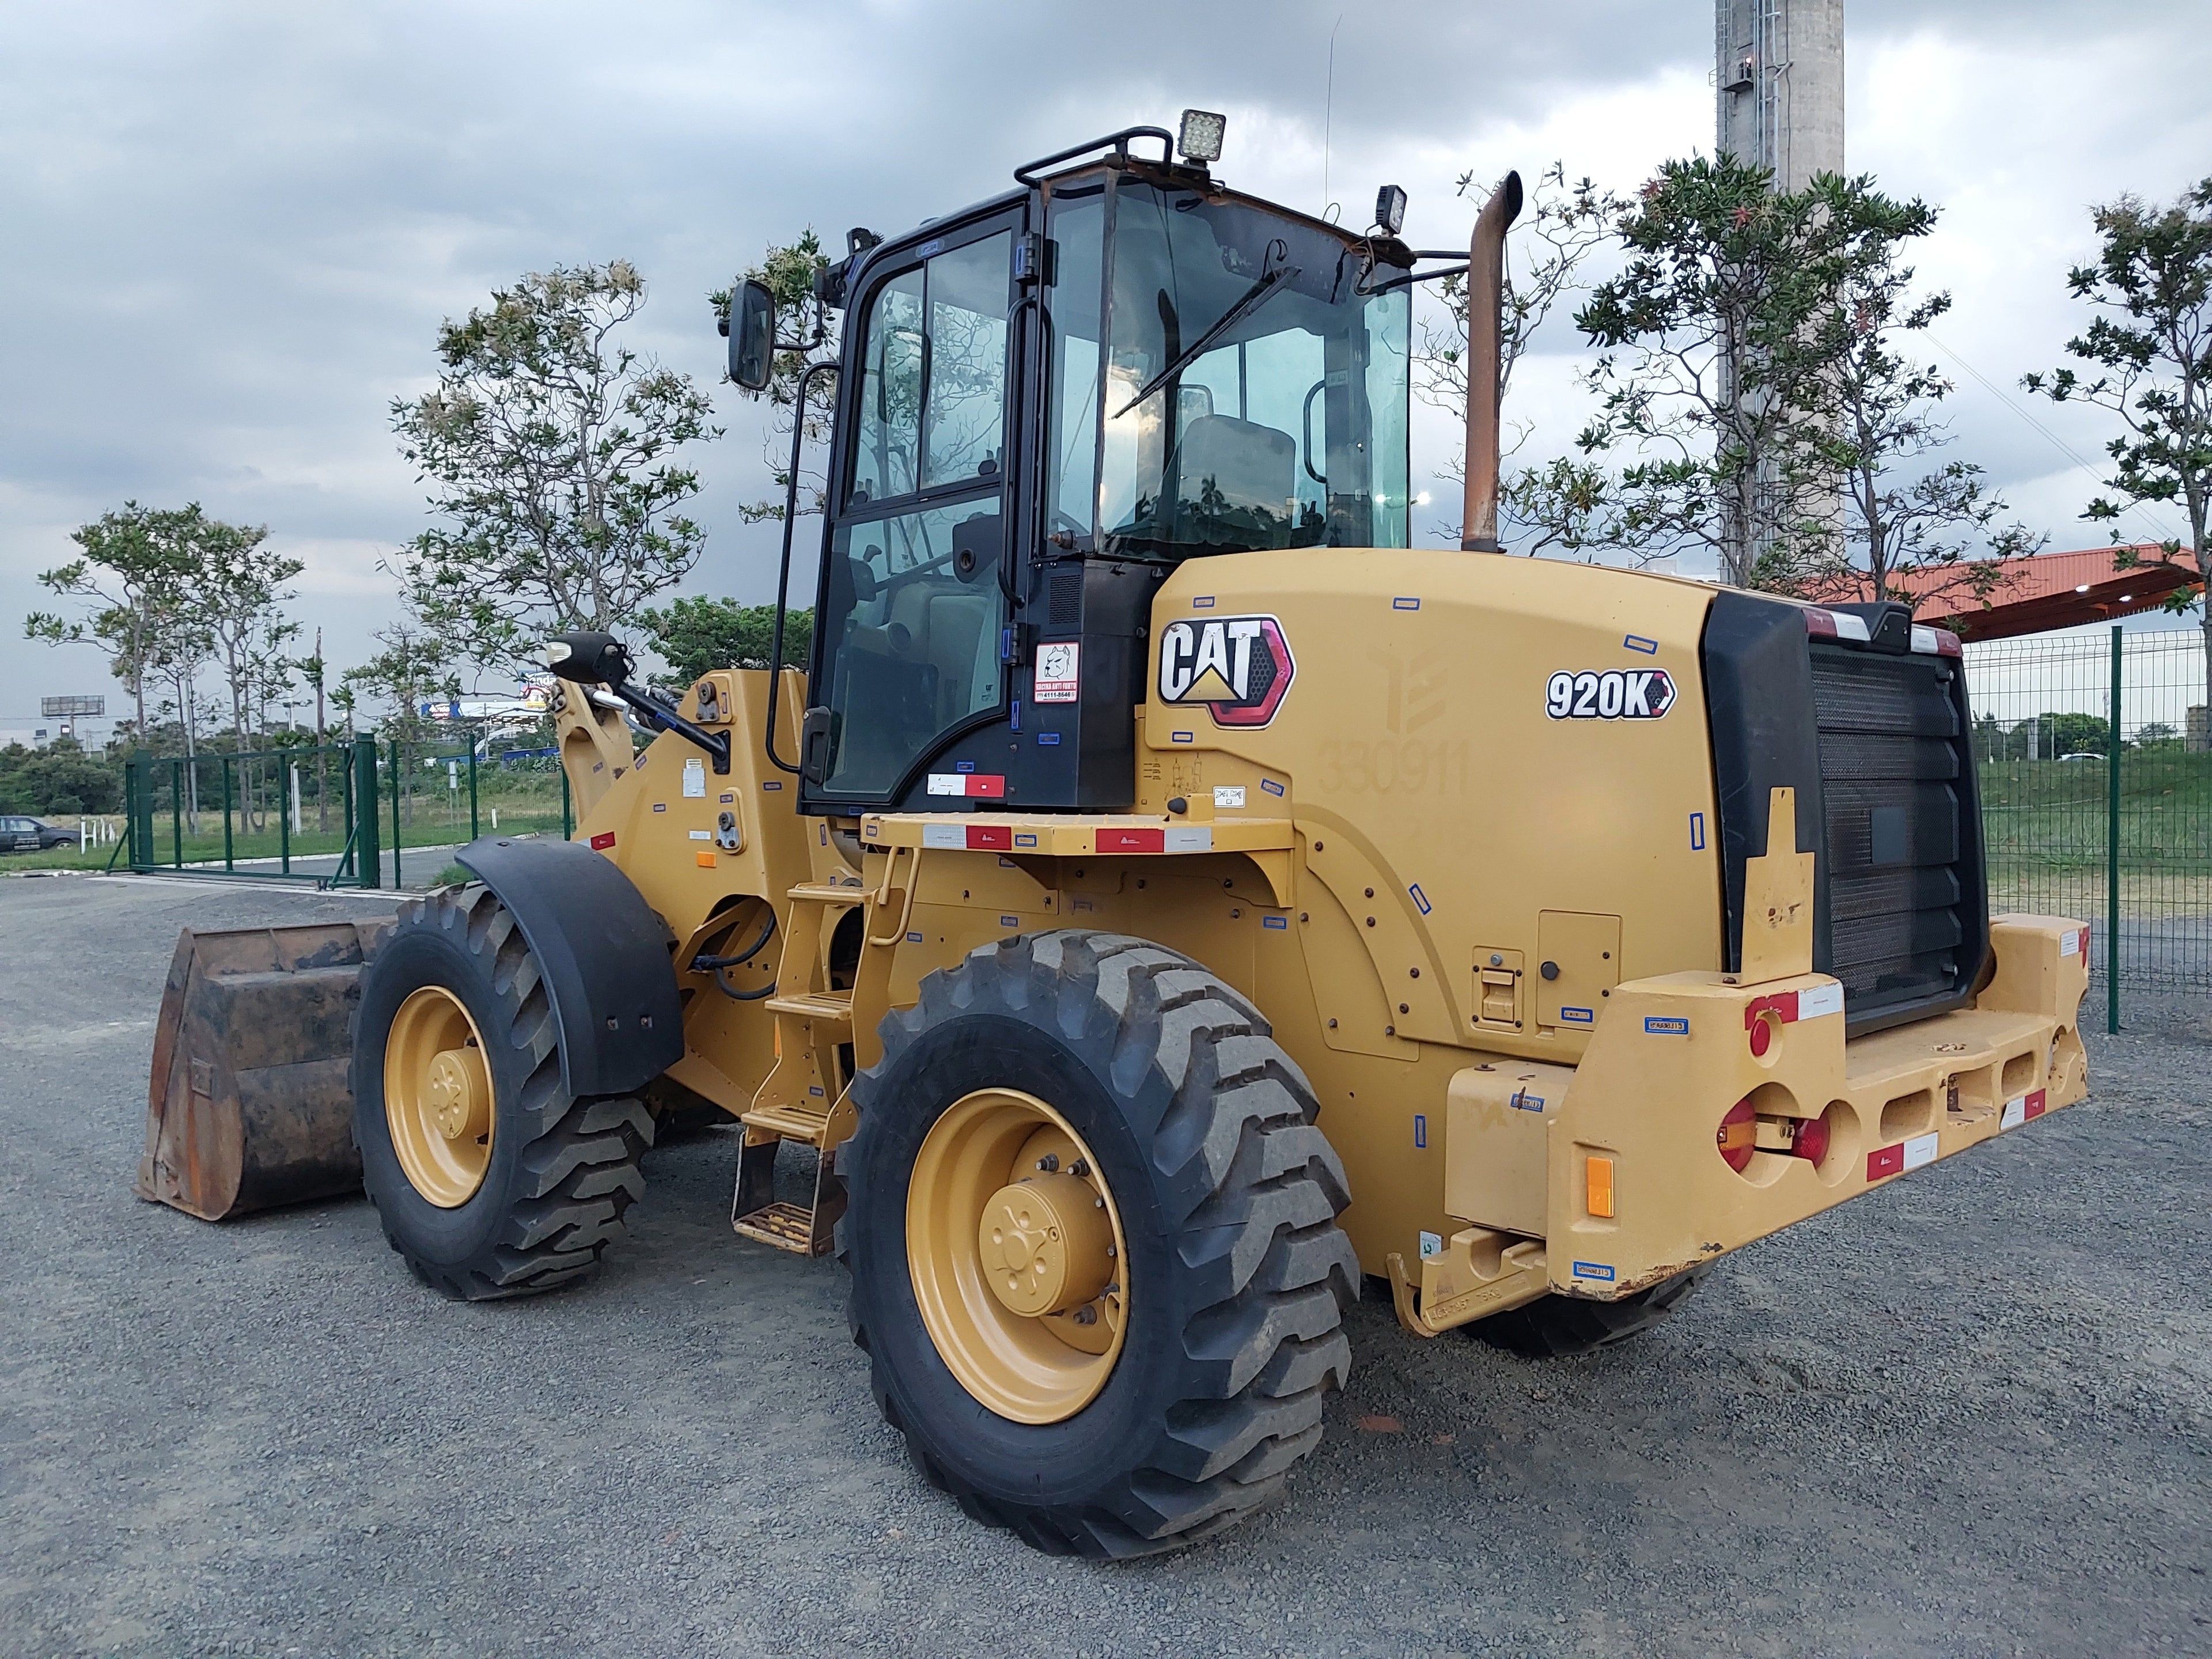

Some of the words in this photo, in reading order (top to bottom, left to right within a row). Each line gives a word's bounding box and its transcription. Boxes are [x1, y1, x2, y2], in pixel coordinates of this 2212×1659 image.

[1161, 620, 1261, 700] CAT
[1549, 673, 1654, 716] 920K
[1318, 738, 1471, 796] 330911
